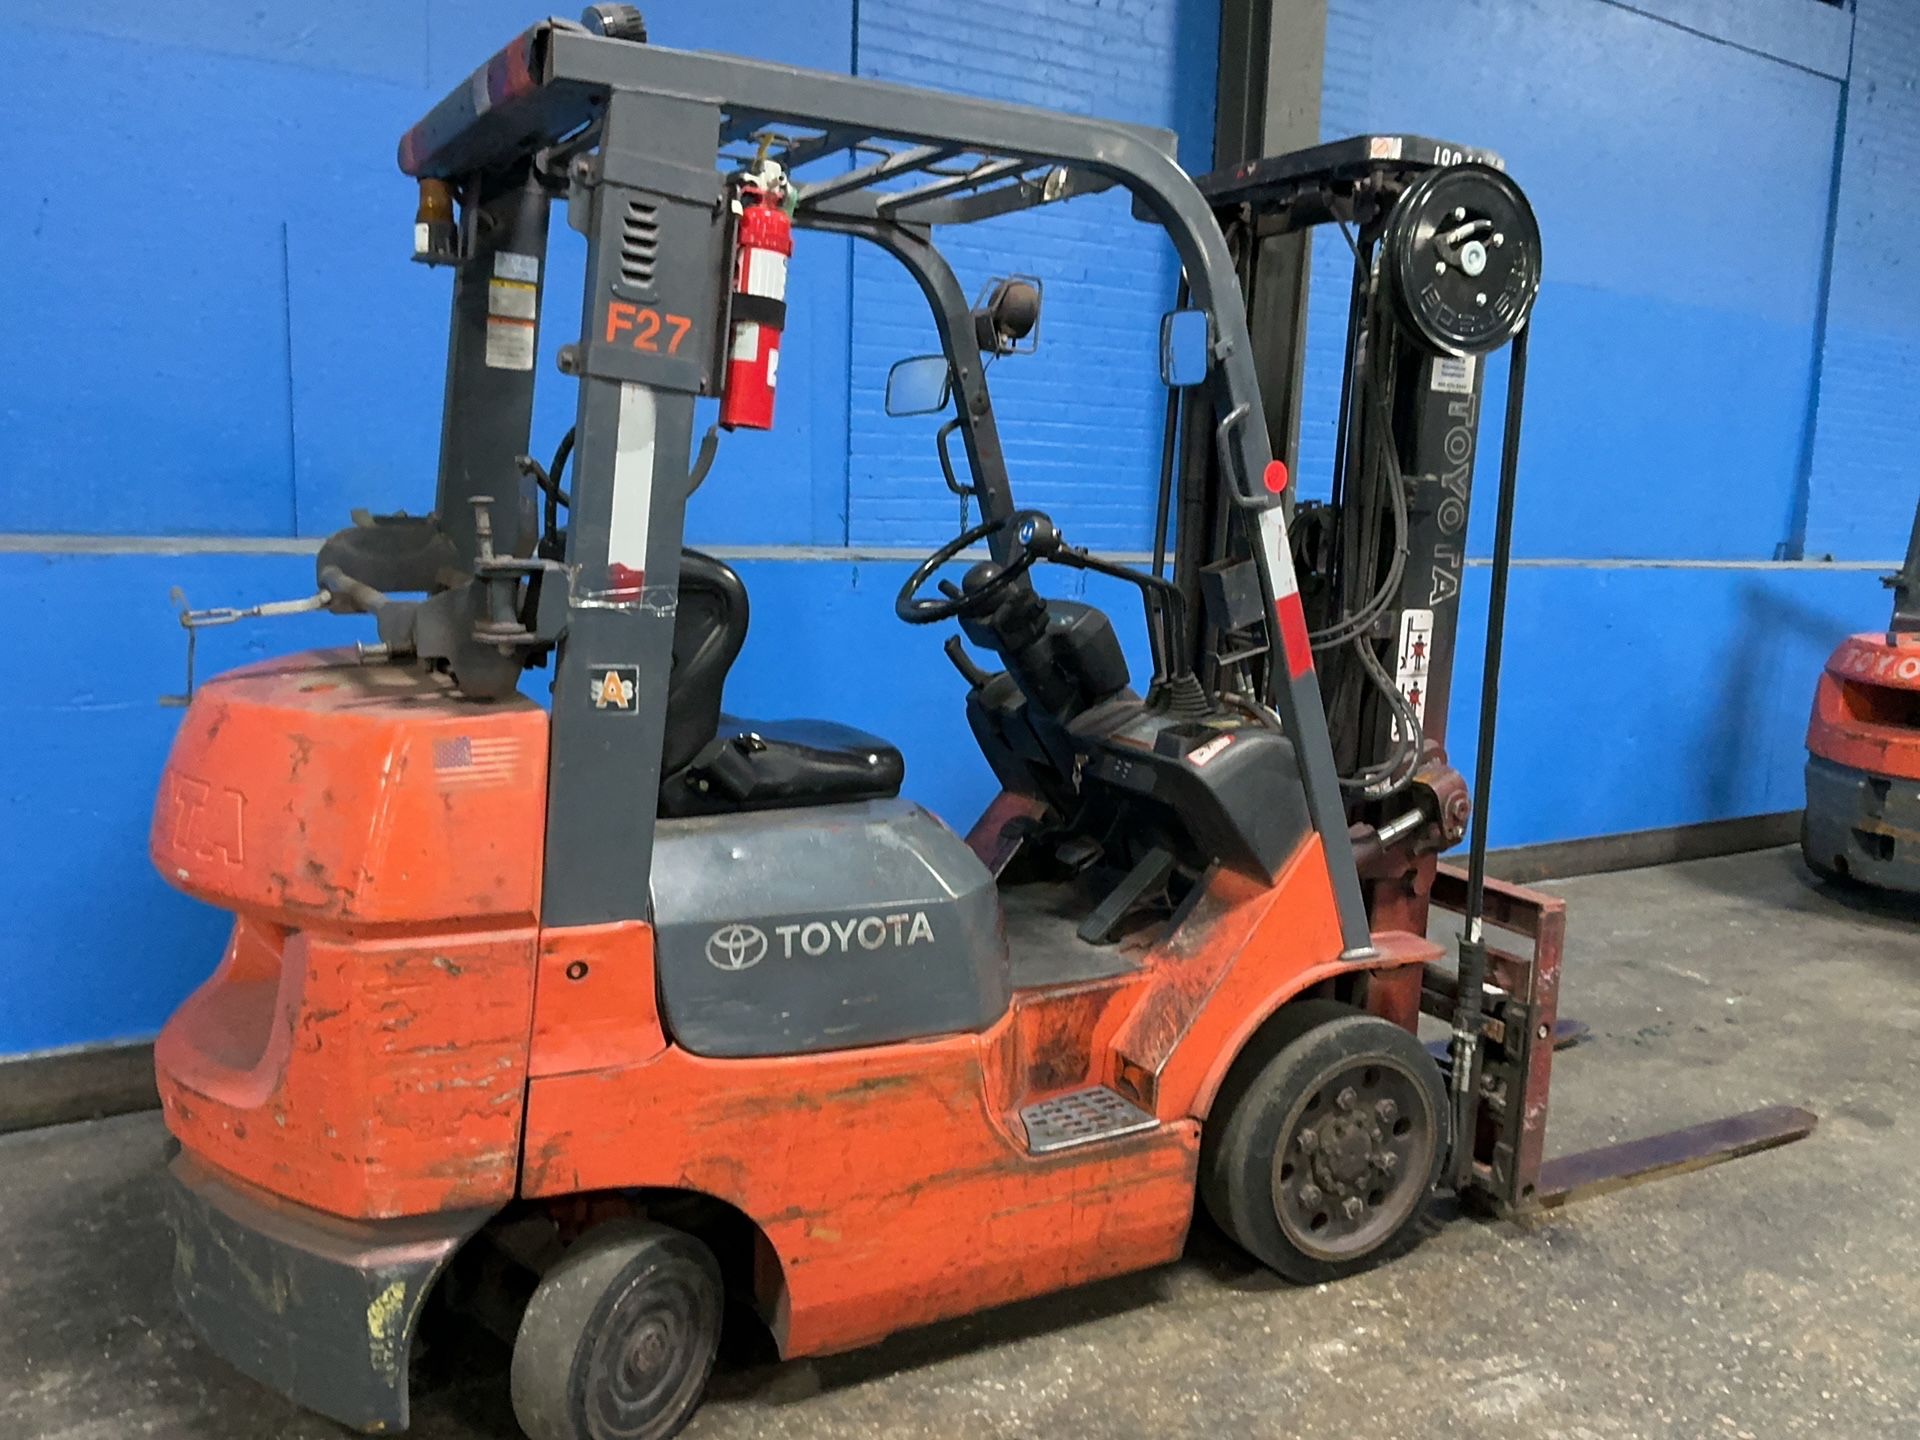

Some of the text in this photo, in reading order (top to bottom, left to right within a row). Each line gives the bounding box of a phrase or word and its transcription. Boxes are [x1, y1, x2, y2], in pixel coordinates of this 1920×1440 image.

[606, 300, 692, 355] F27
[1430, 394, 1476, 607] TOYOTA
[776, 911, 935, 959] TOYOTA
